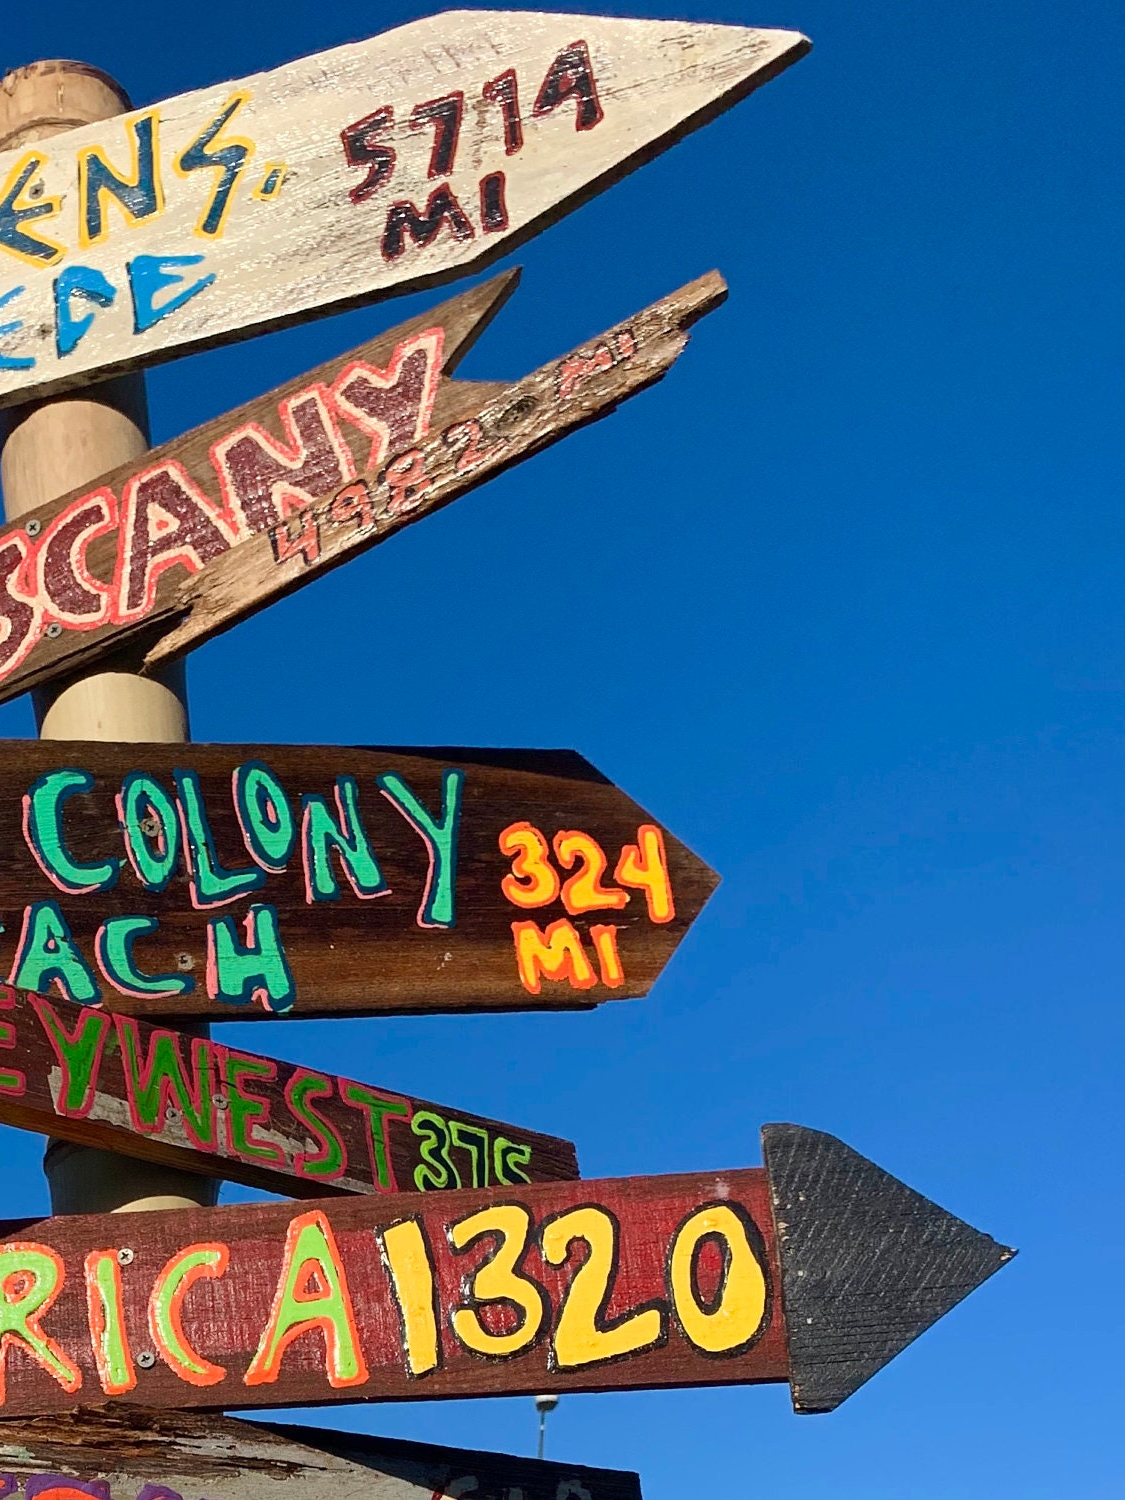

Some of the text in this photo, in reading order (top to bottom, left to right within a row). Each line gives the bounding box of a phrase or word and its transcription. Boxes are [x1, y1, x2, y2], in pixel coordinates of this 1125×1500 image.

[380, 170, 510, 262] MI
[268, 417, 507, 566] 4982
[22, 759, 465, 929] COLONY
[499, 821, 676, 924] 324
[511, 918, 624, 994] MI
[375, 1199, 771, 1381] 1320
